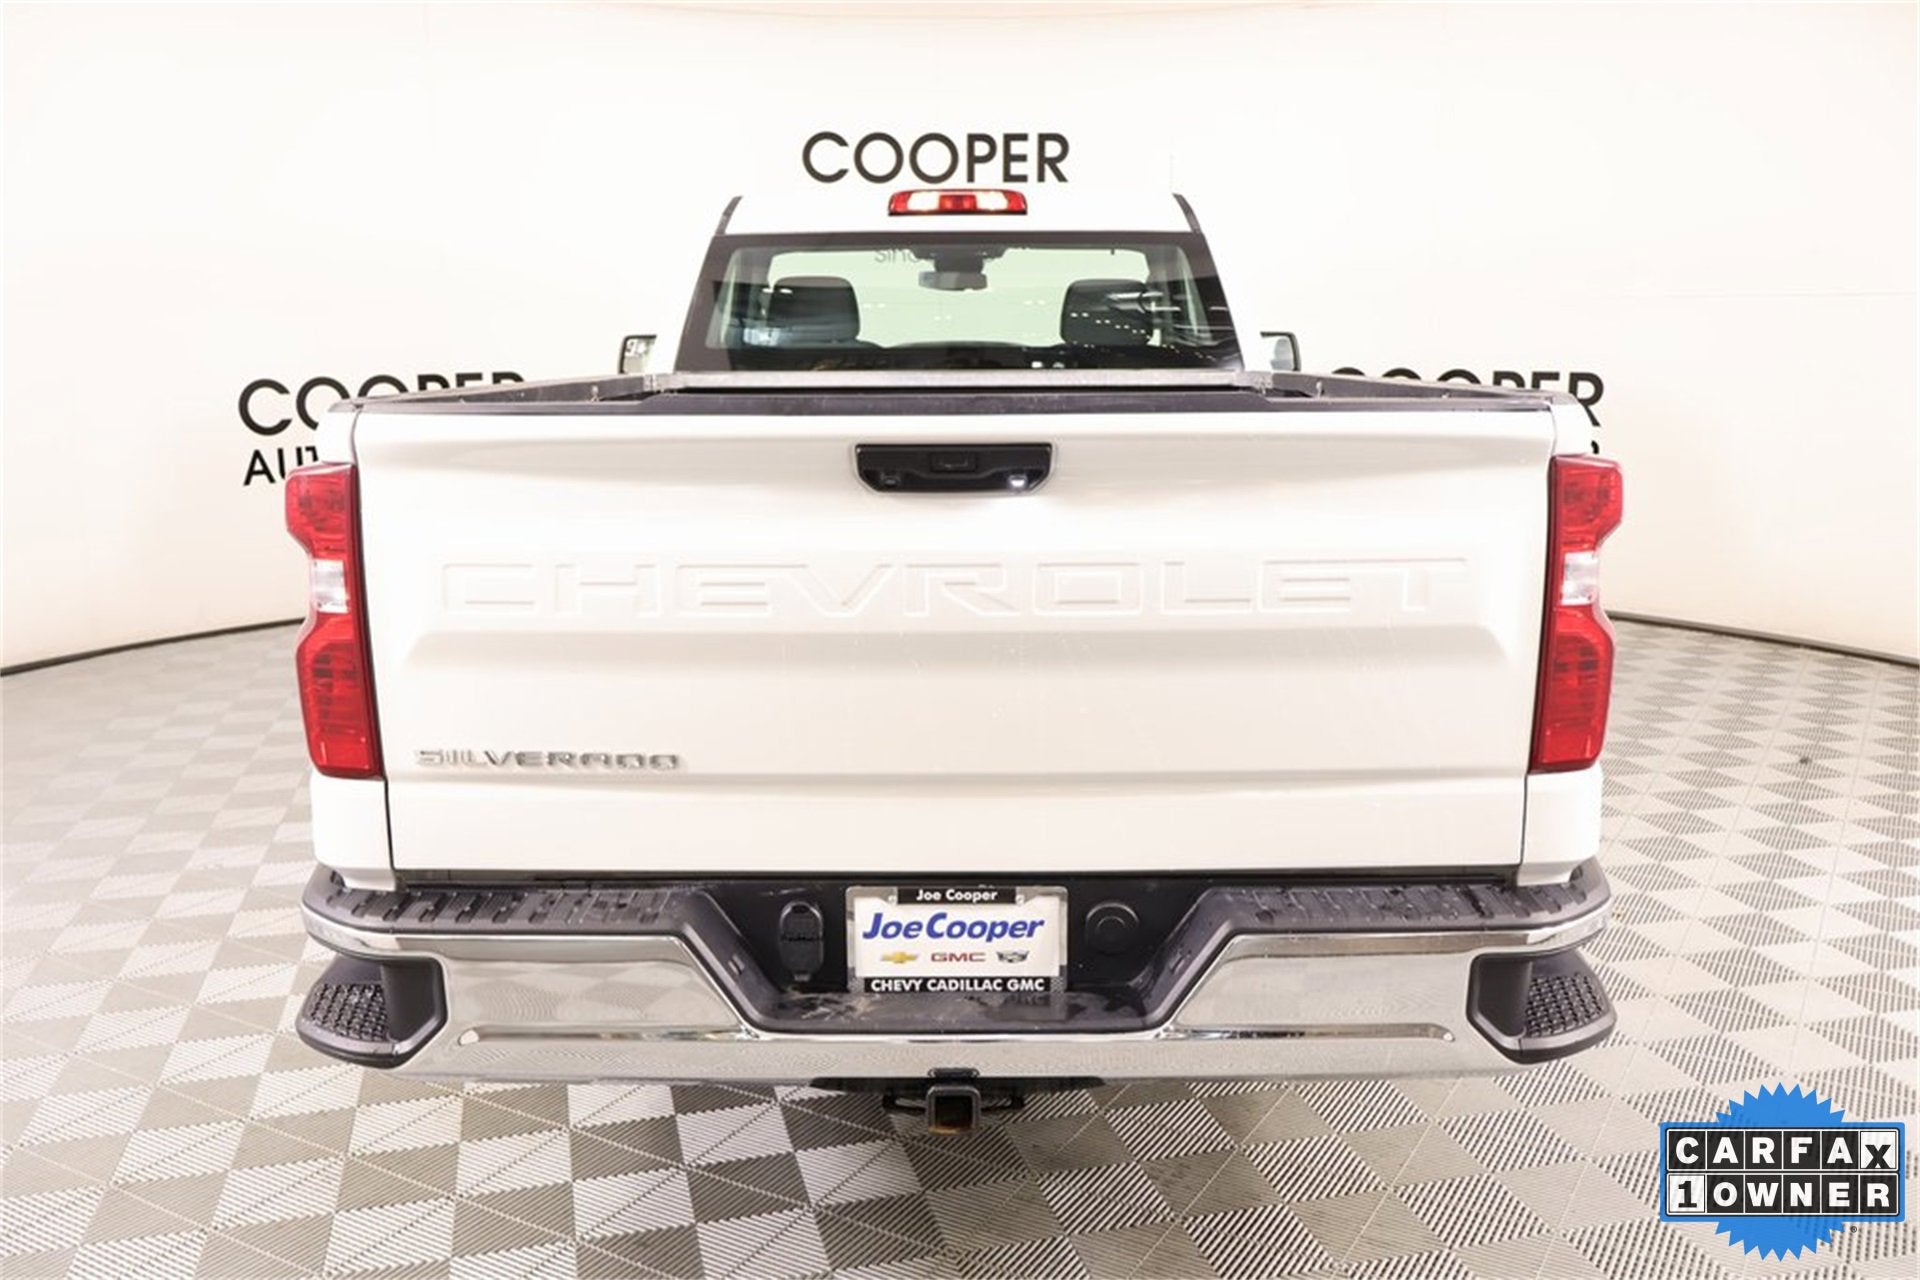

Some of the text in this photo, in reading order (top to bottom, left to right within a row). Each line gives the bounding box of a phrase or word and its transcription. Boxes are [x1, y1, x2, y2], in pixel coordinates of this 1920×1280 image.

[802, 131, 1070, 184] COOPER
[441, 558, 1467, 616] CHEVROLET
[418, 749, 680, 769] SILVERADO
[916, 889, 998, 904] Joe Cooper
[930, 952, 986, 962] GMC
[871, 979, 1045, 991] CHEVY CADILLAC GMC
